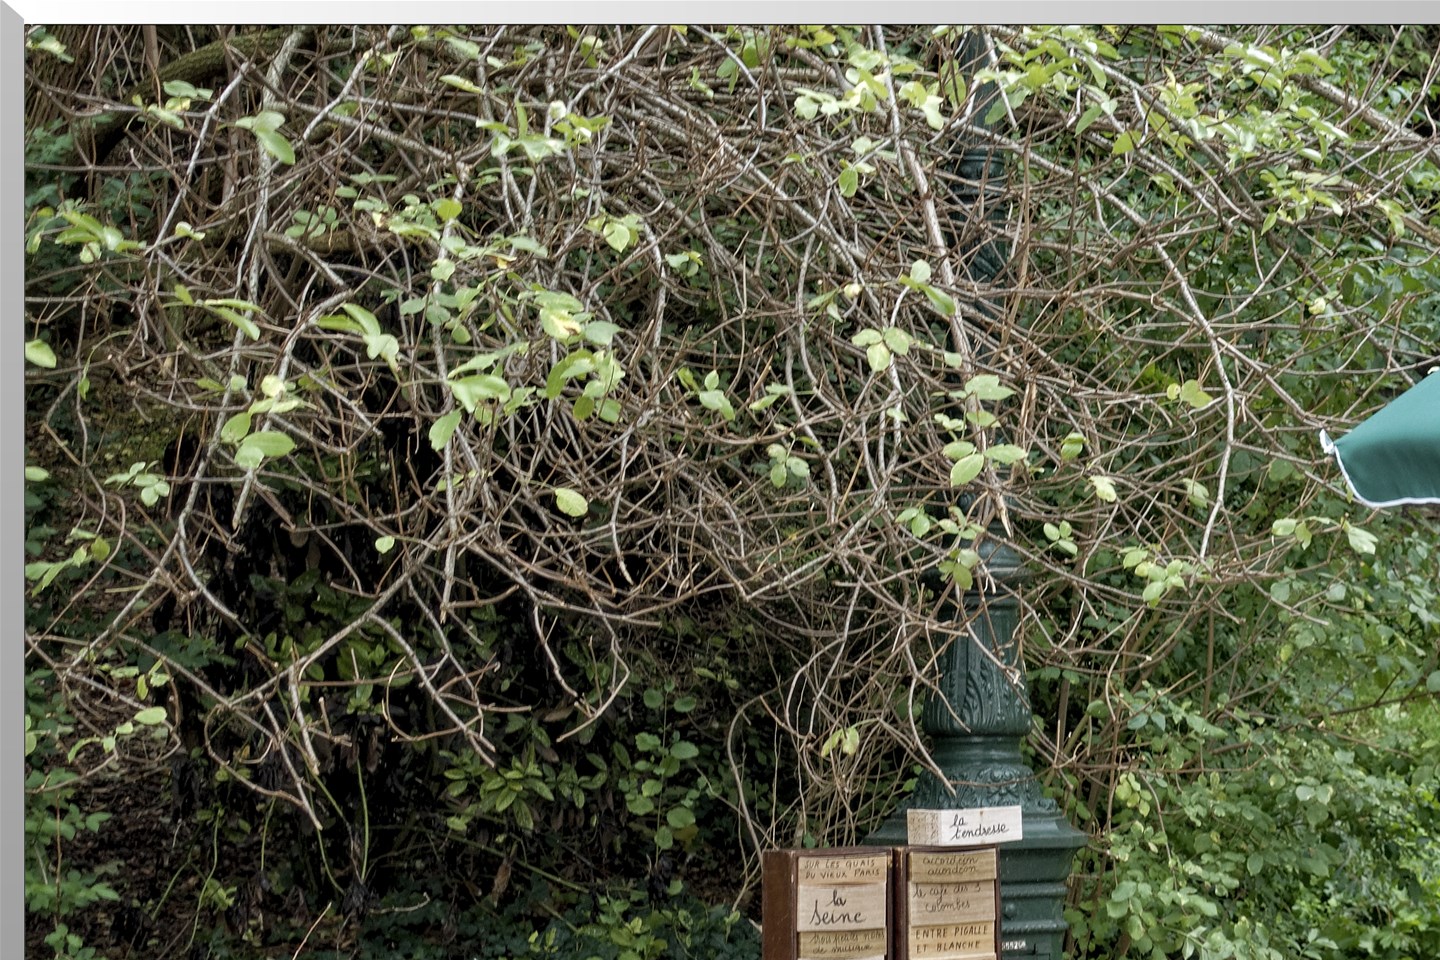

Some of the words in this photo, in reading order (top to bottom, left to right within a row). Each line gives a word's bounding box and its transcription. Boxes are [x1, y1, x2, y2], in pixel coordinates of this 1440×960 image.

[950, 813, 966, 828] la
[825, 889, 847, 907] la
[915, 927, 948, 940] ENTRE
[954, 925, 989, 937] PIGALLE
[916, 944, 928, 954] ET
[936, 940, 981, 953] BLANCHE
